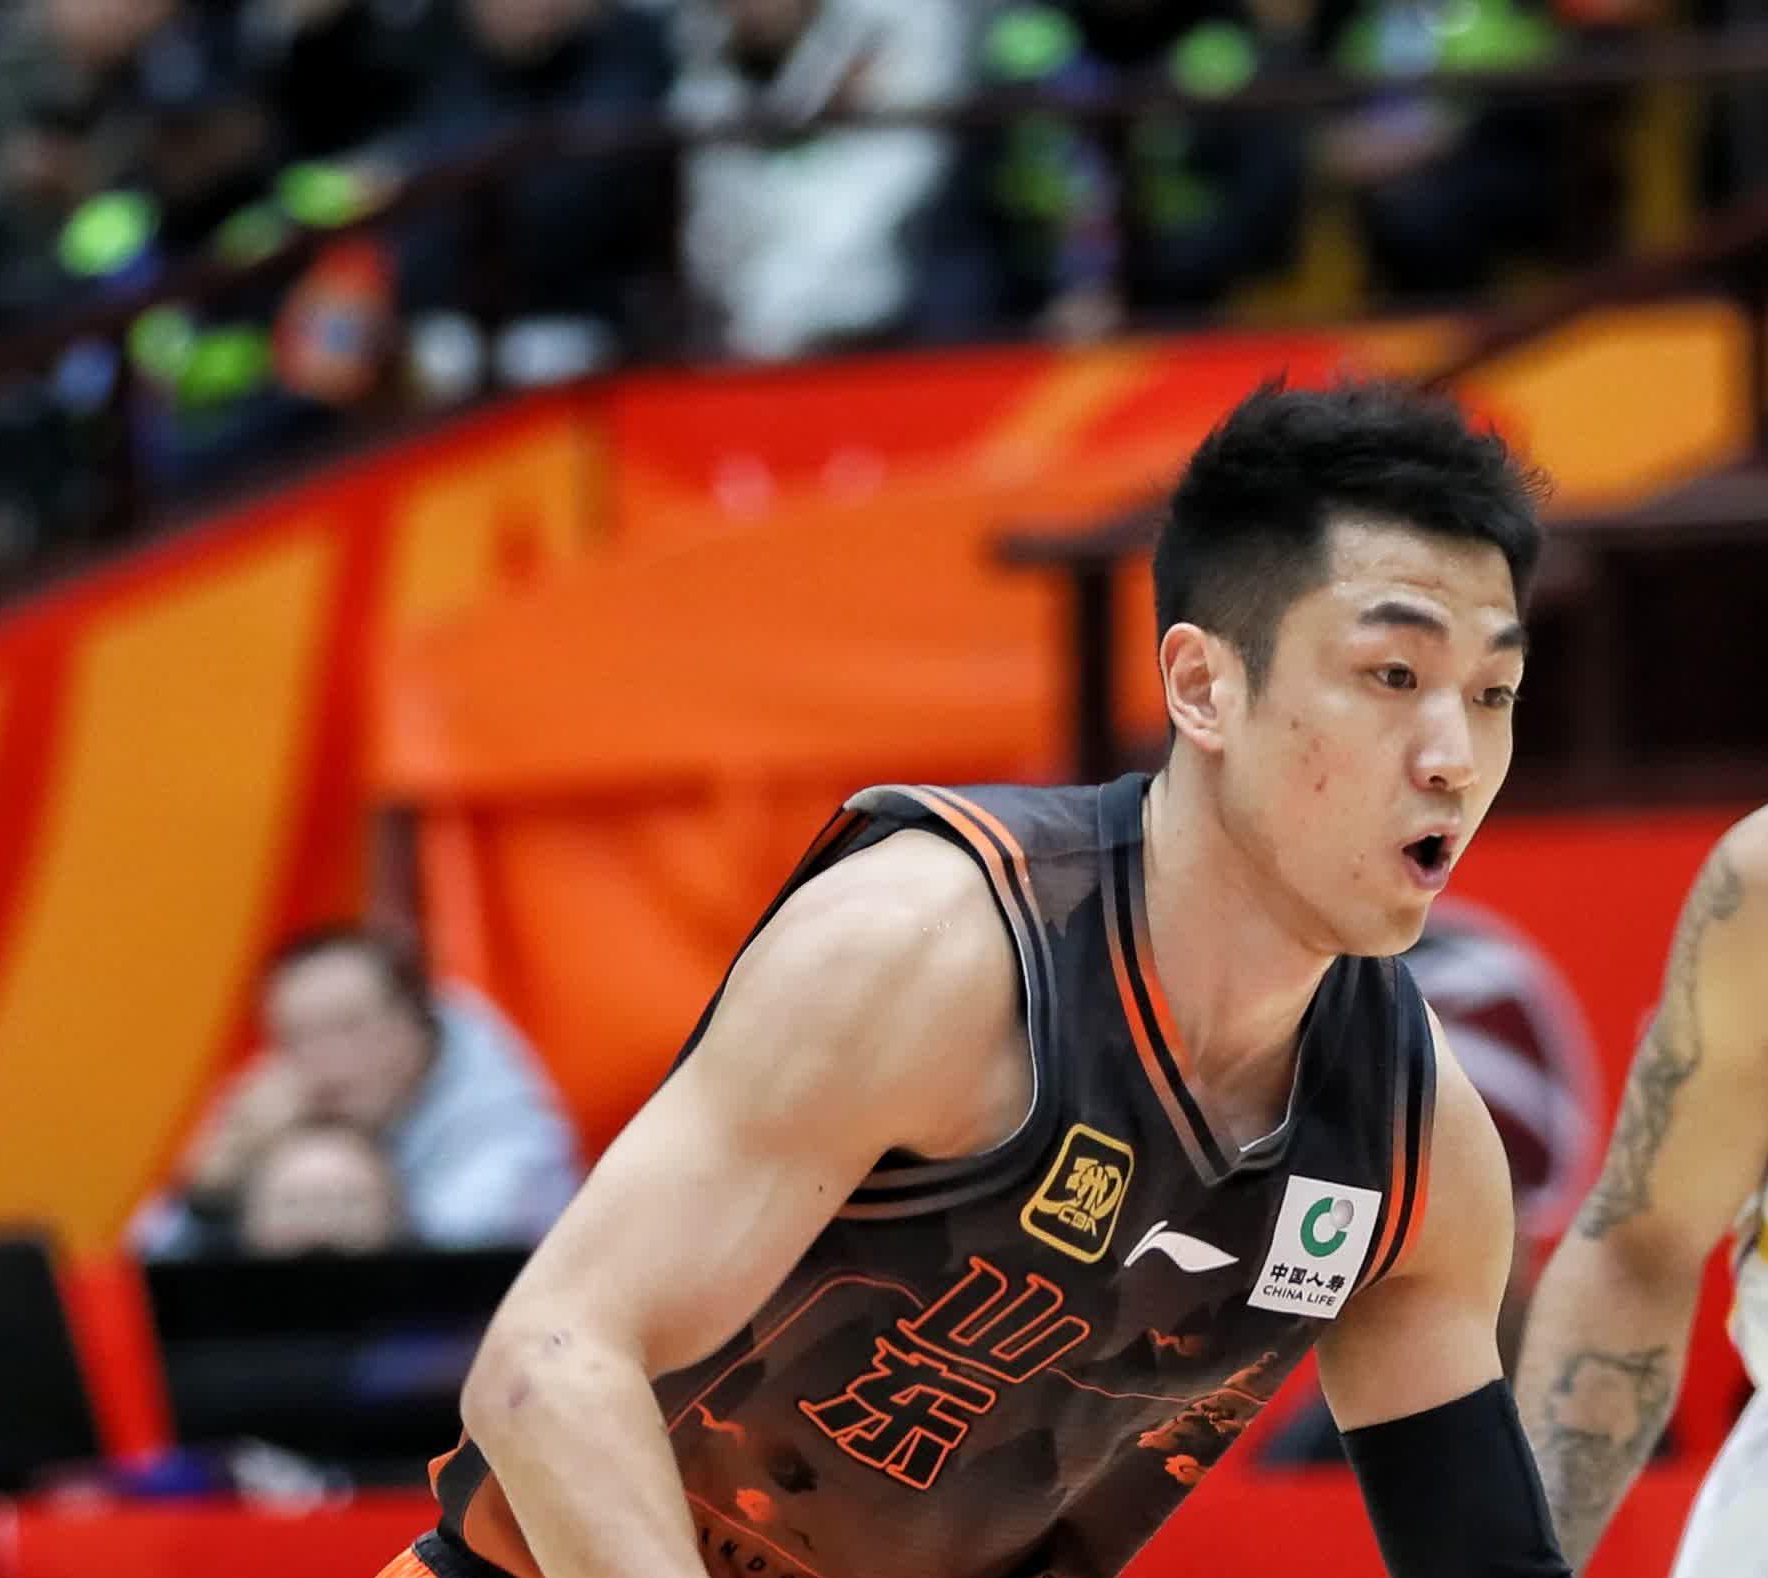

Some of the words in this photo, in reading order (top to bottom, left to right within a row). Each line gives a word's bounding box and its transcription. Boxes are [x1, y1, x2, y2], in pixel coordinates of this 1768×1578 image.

[1269, 1263, 1346, 1294] 中国人寿
[1262, 1284, 1305, 1304] CHINA
[1306, 1289, 1337, 1307] LIFE
[796, 1254, 1091, 1492] 山东
